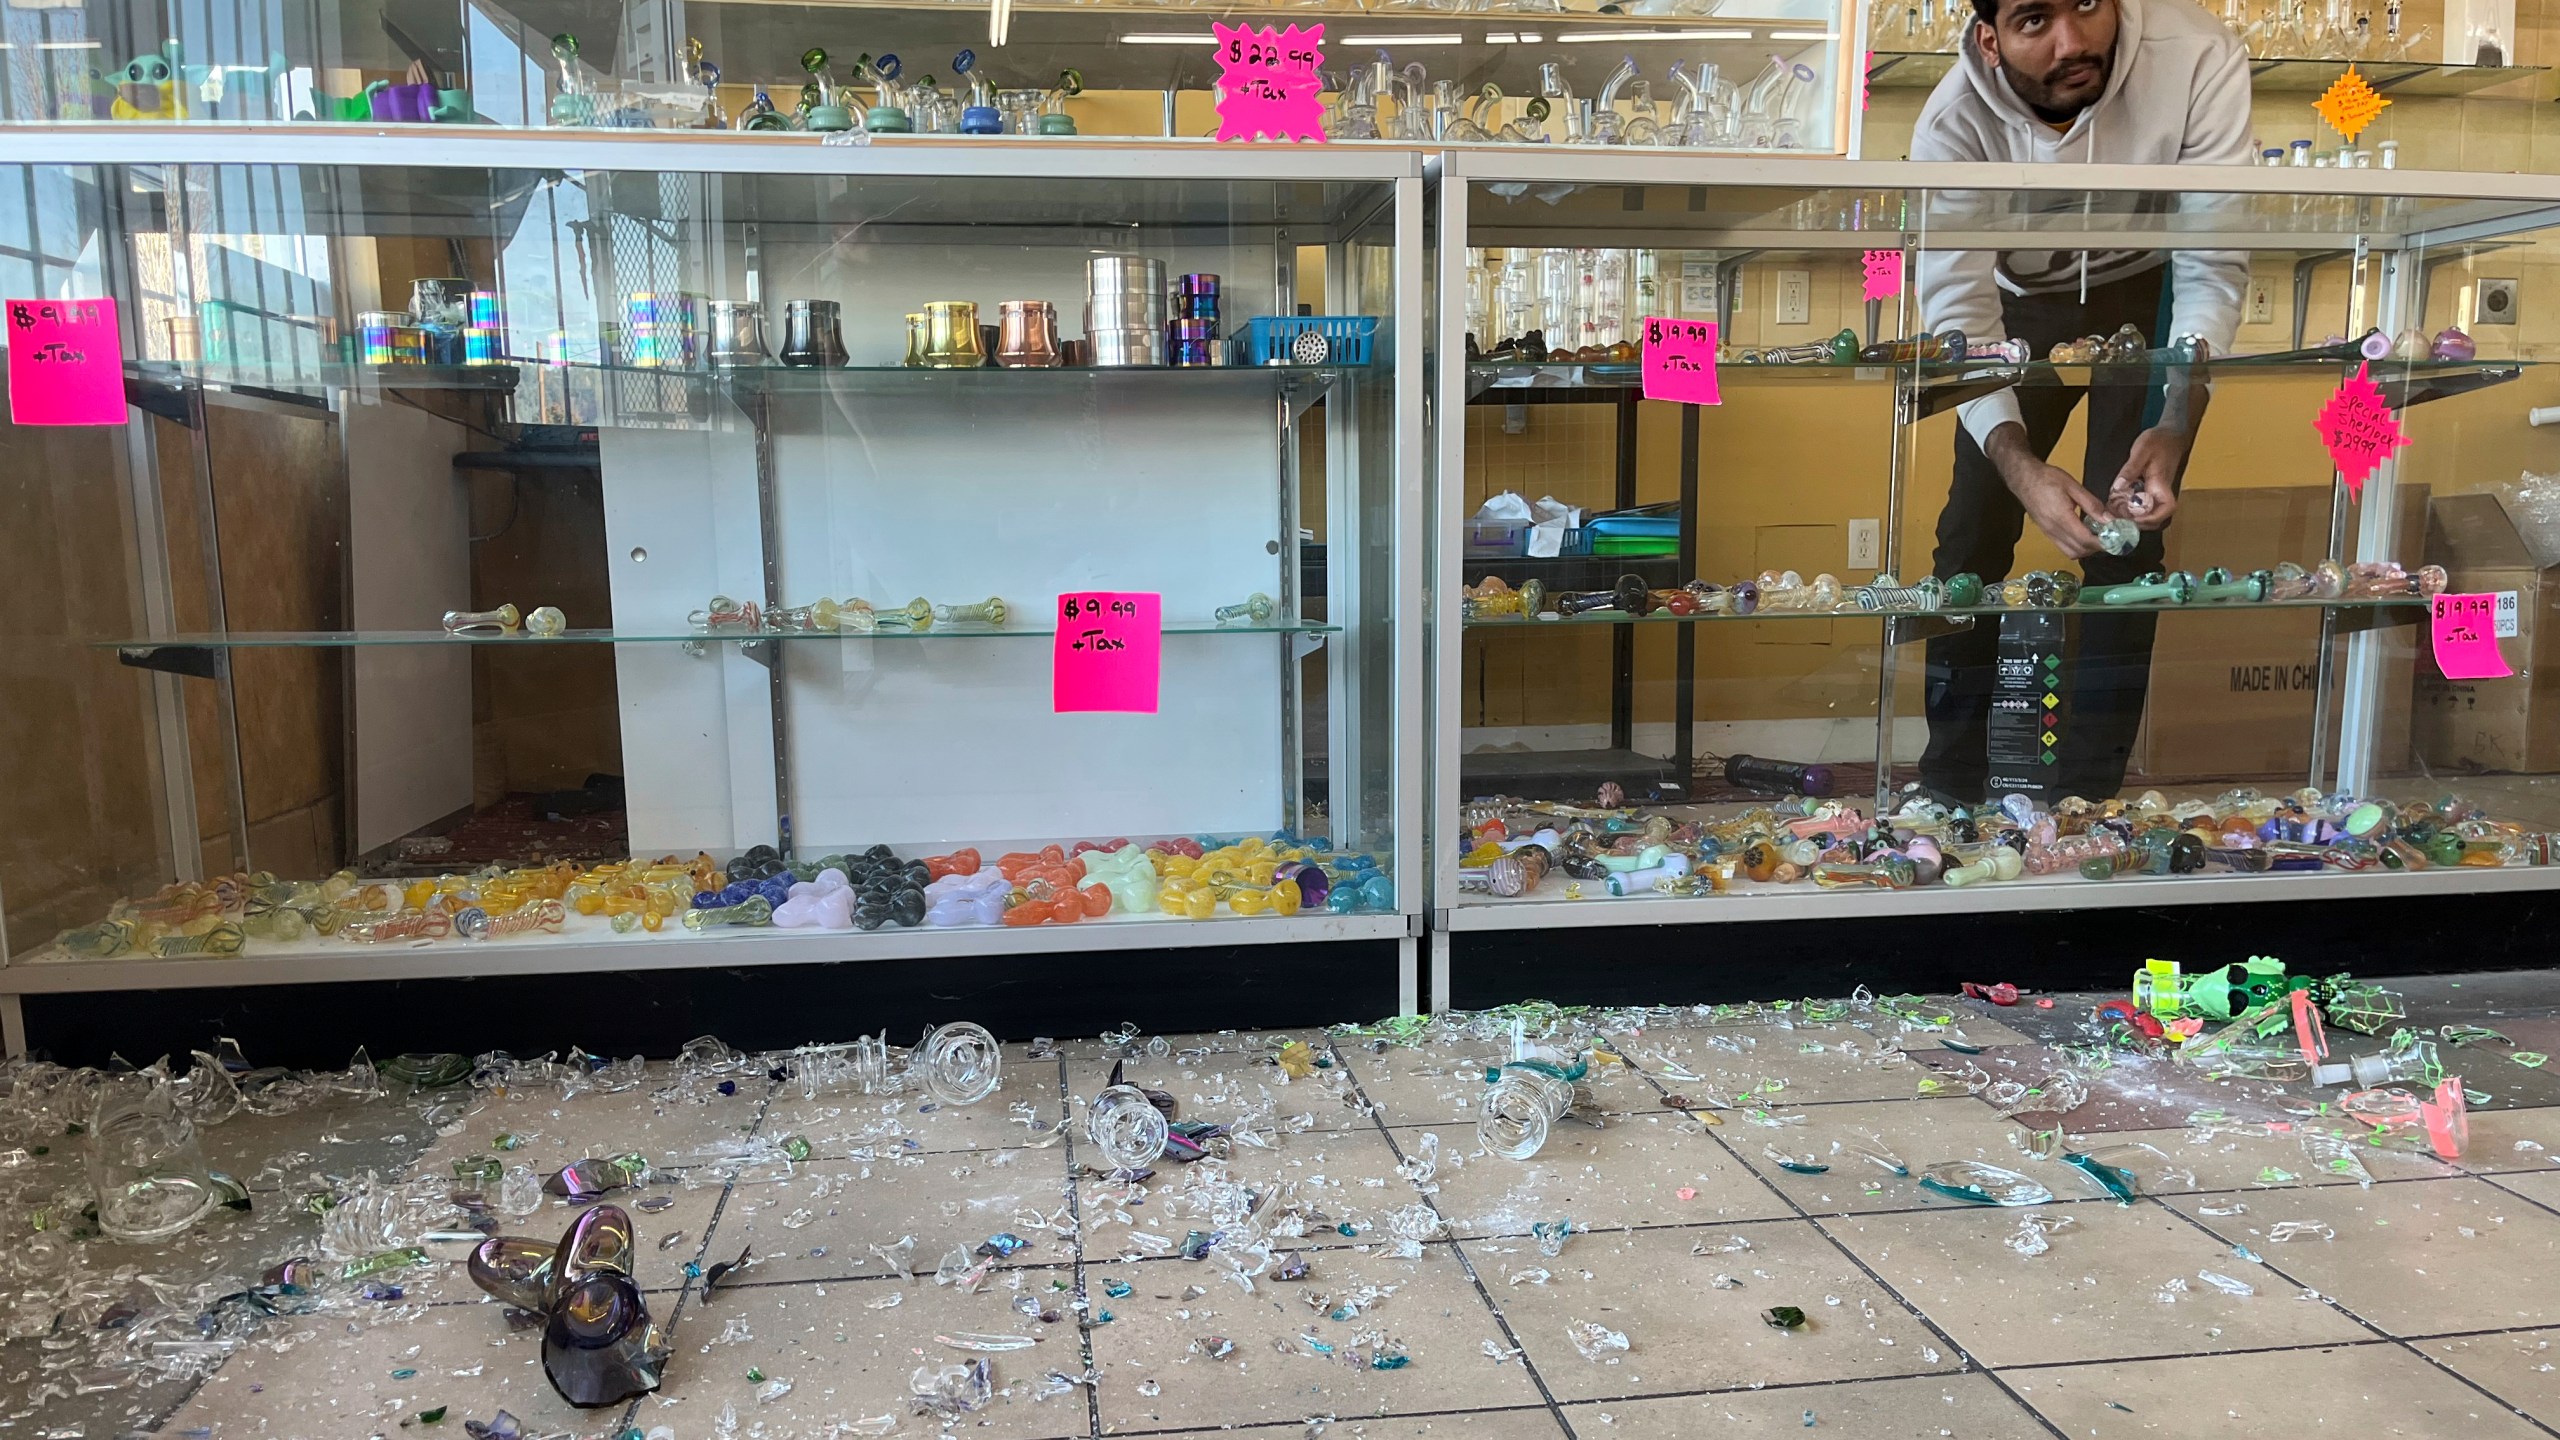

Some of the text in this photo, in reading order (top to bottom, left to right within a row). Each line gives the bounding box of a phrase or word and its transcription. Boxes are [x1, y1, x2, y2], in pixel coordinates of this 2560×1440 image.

[1240, 79, 1287, 100] +Tax
[1662, 355, 1702, 372] +Tax
[1072, 629, 1126, 652] +Tax
[2444, 627, 2479, 643] +Tax
[2230, 666, 2271, 692] MADE
[2274, 665, 2289, 691] IN
